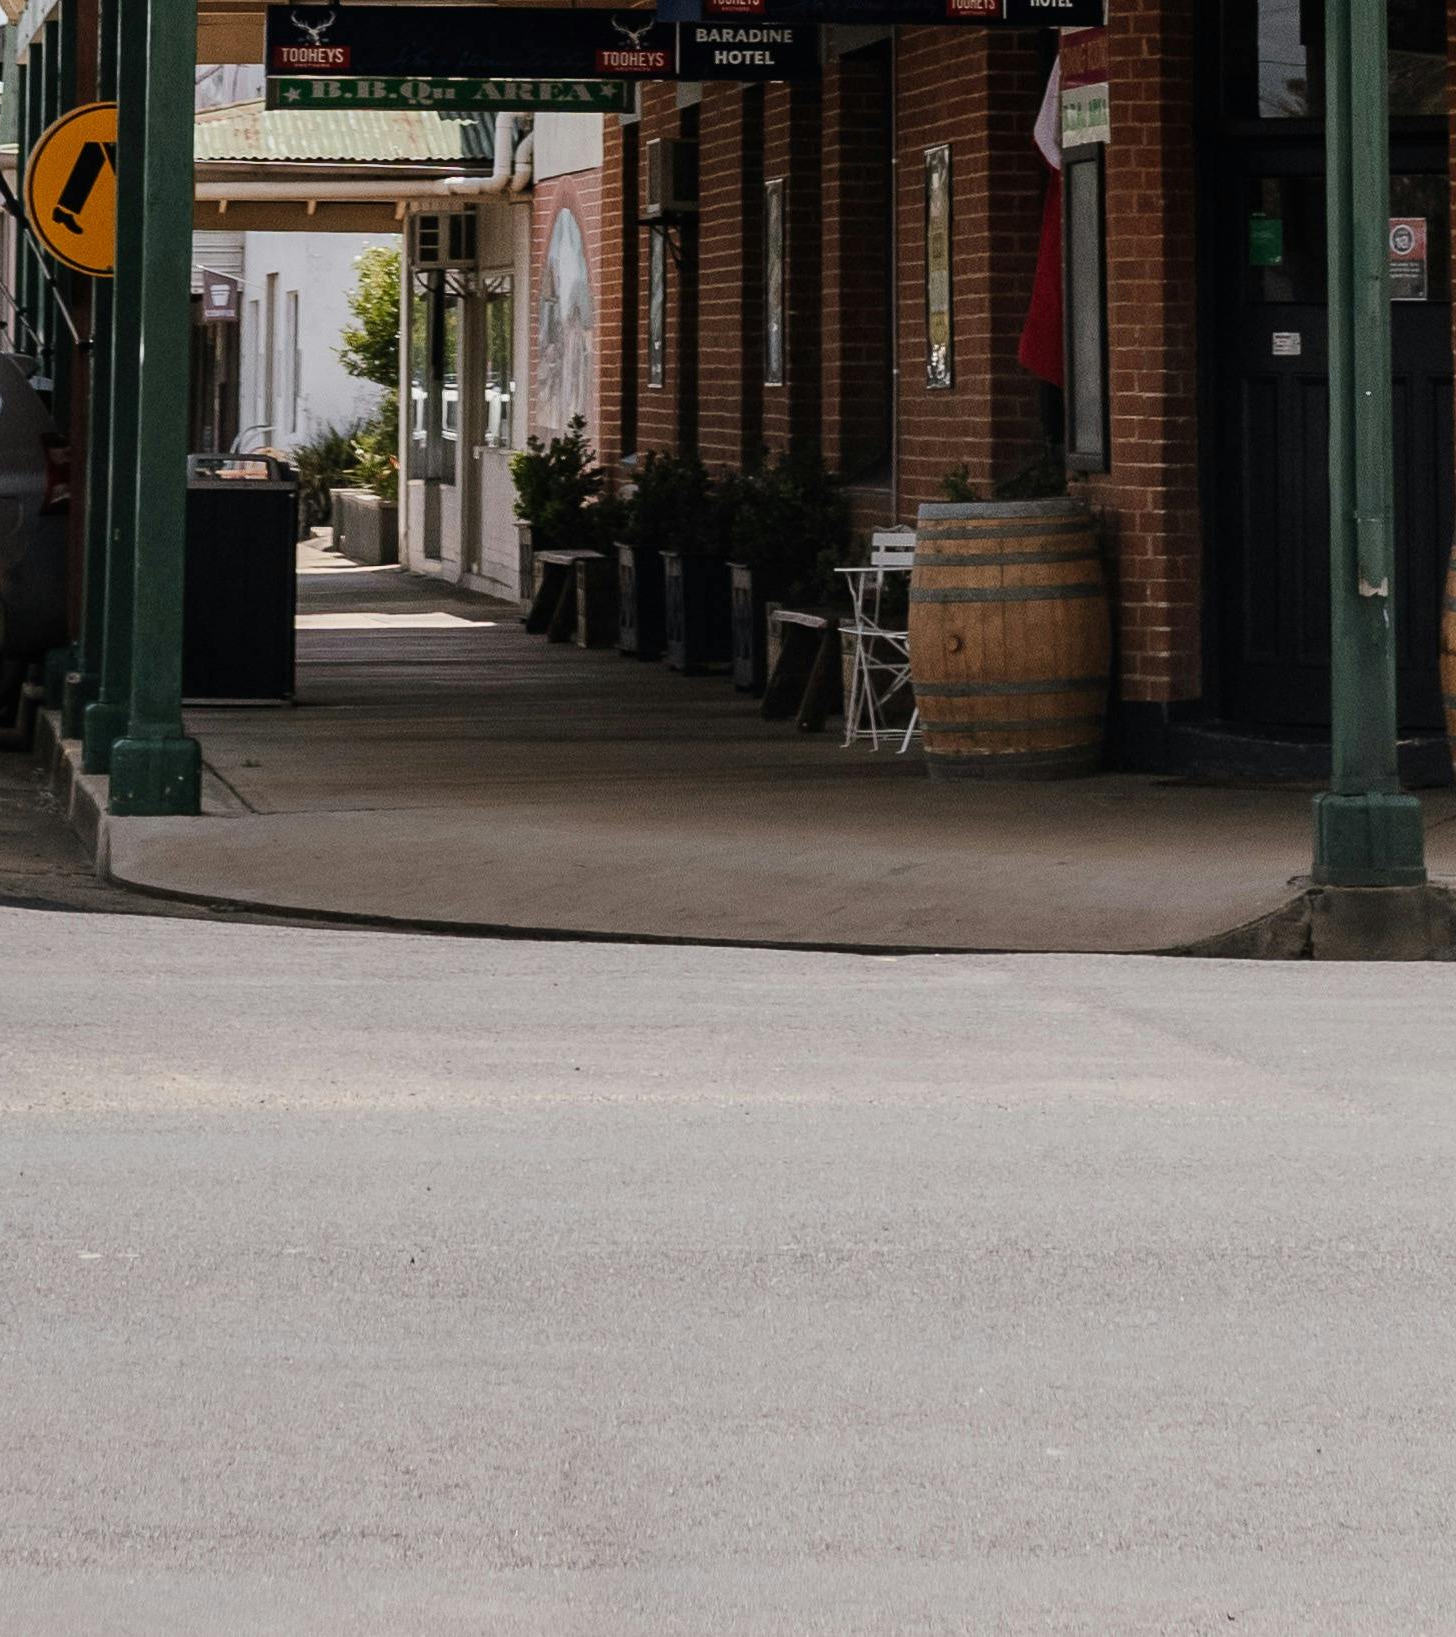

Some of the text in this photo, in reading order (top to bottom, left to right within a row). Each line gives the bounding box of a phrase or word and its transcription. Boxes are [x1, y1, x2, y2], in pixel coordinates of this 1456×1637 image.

[695, 27, 794, 45] BARADINE
[281, 47, 345, 64] TOOHEYS
[601, 50, 666, 68] TOOHEYS
[713, 49, 776, 66] HOTEL
[473, 80, 594, 103] AREA
